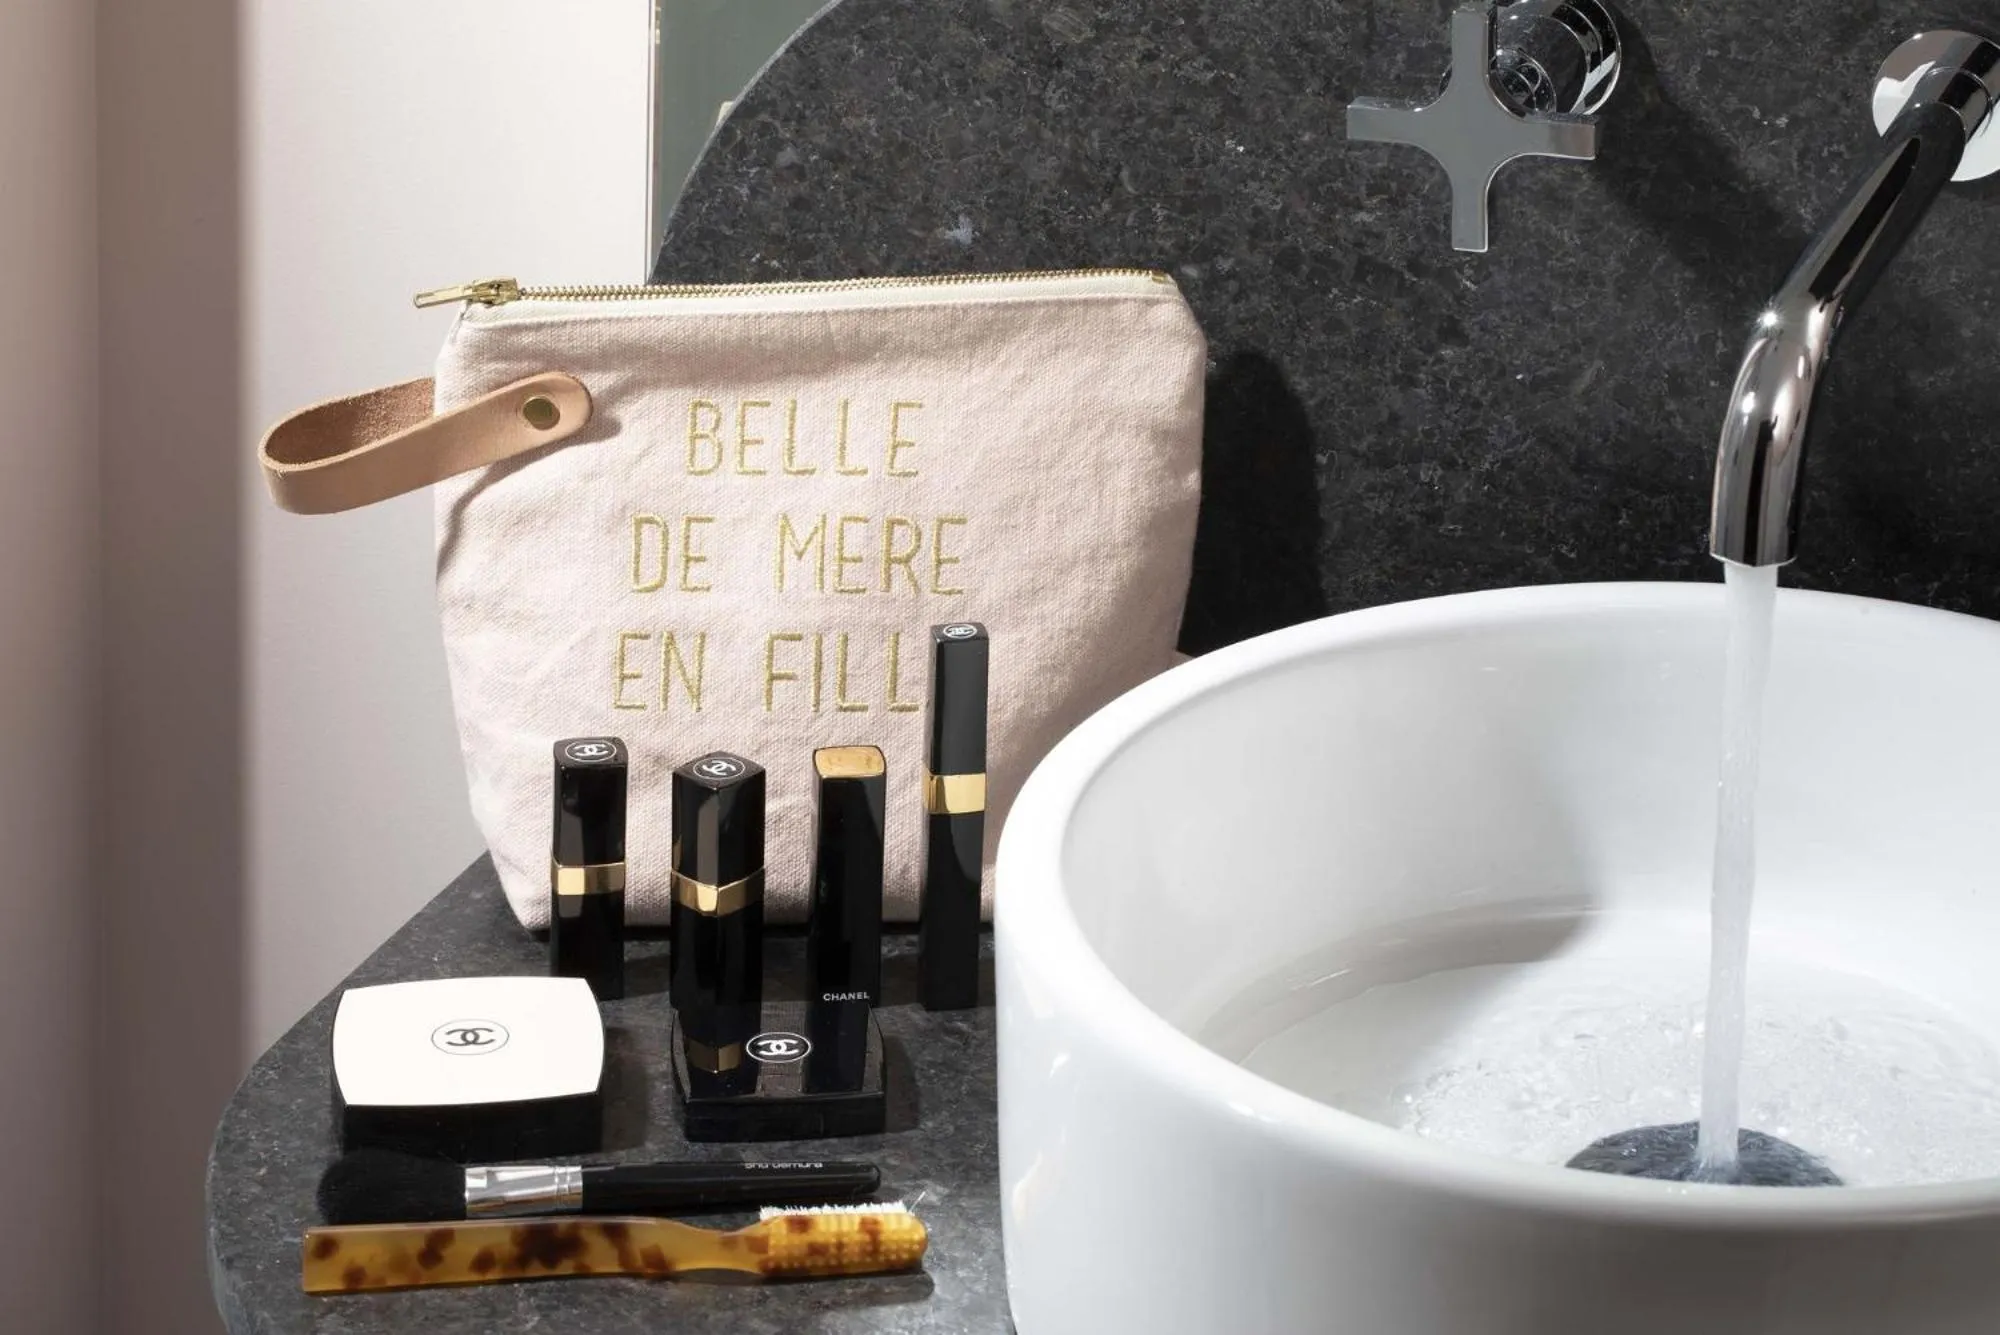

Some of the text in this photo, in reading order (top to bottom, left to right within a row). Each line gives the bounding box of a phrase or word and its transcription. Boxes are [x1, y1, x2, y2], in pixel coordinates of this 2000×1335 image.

[687, 399, 923, 477] BELLE
[632, 513, 968, 595] DE MERE
[613, 631, 929, 713] EN FILL
[823, 991, 870, 1001] CHANEL
